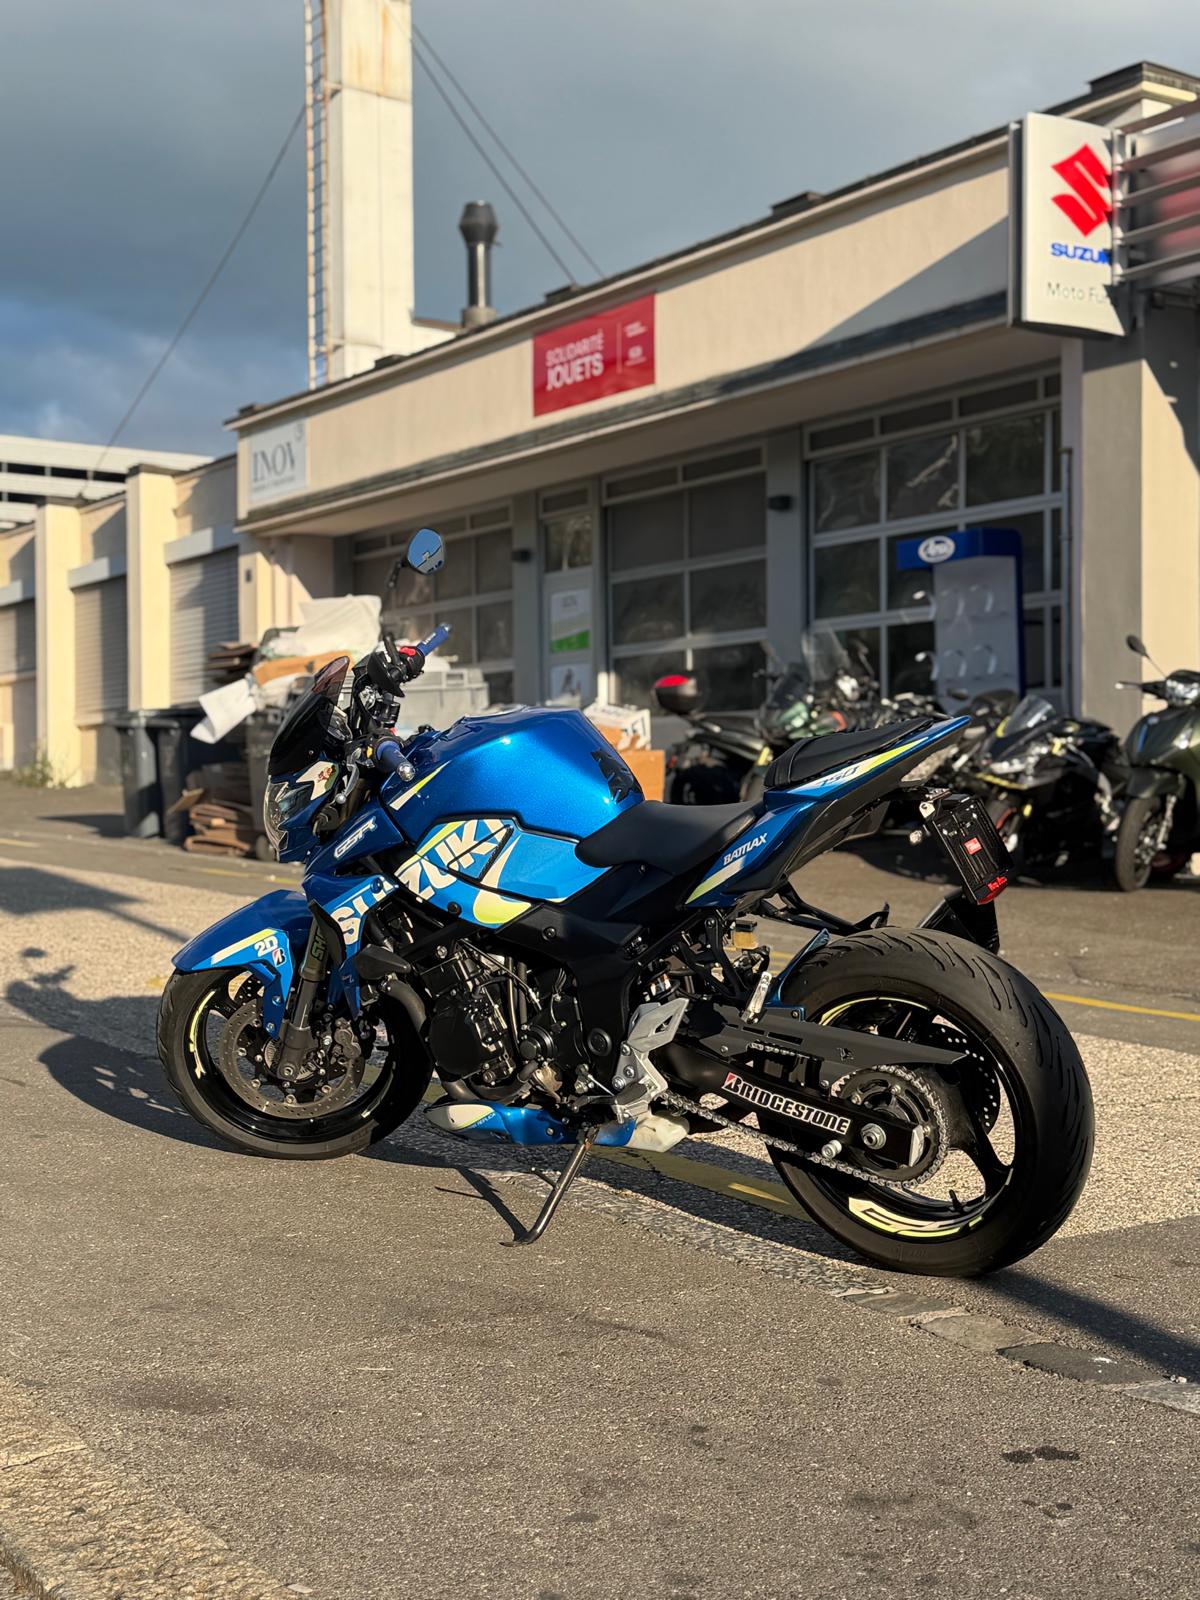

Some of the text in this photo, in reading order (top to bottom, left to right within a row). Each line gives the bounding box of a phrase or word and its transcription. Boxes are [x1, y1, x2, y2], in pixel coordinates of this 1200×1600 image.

[1046, 282, 1085, 301] Moto
[546, 352, 604, 391] JOUETS
[724, 832, 768, 866] BATTLAX
[721, 1071, 851, 1135] BRIDGESTONE
